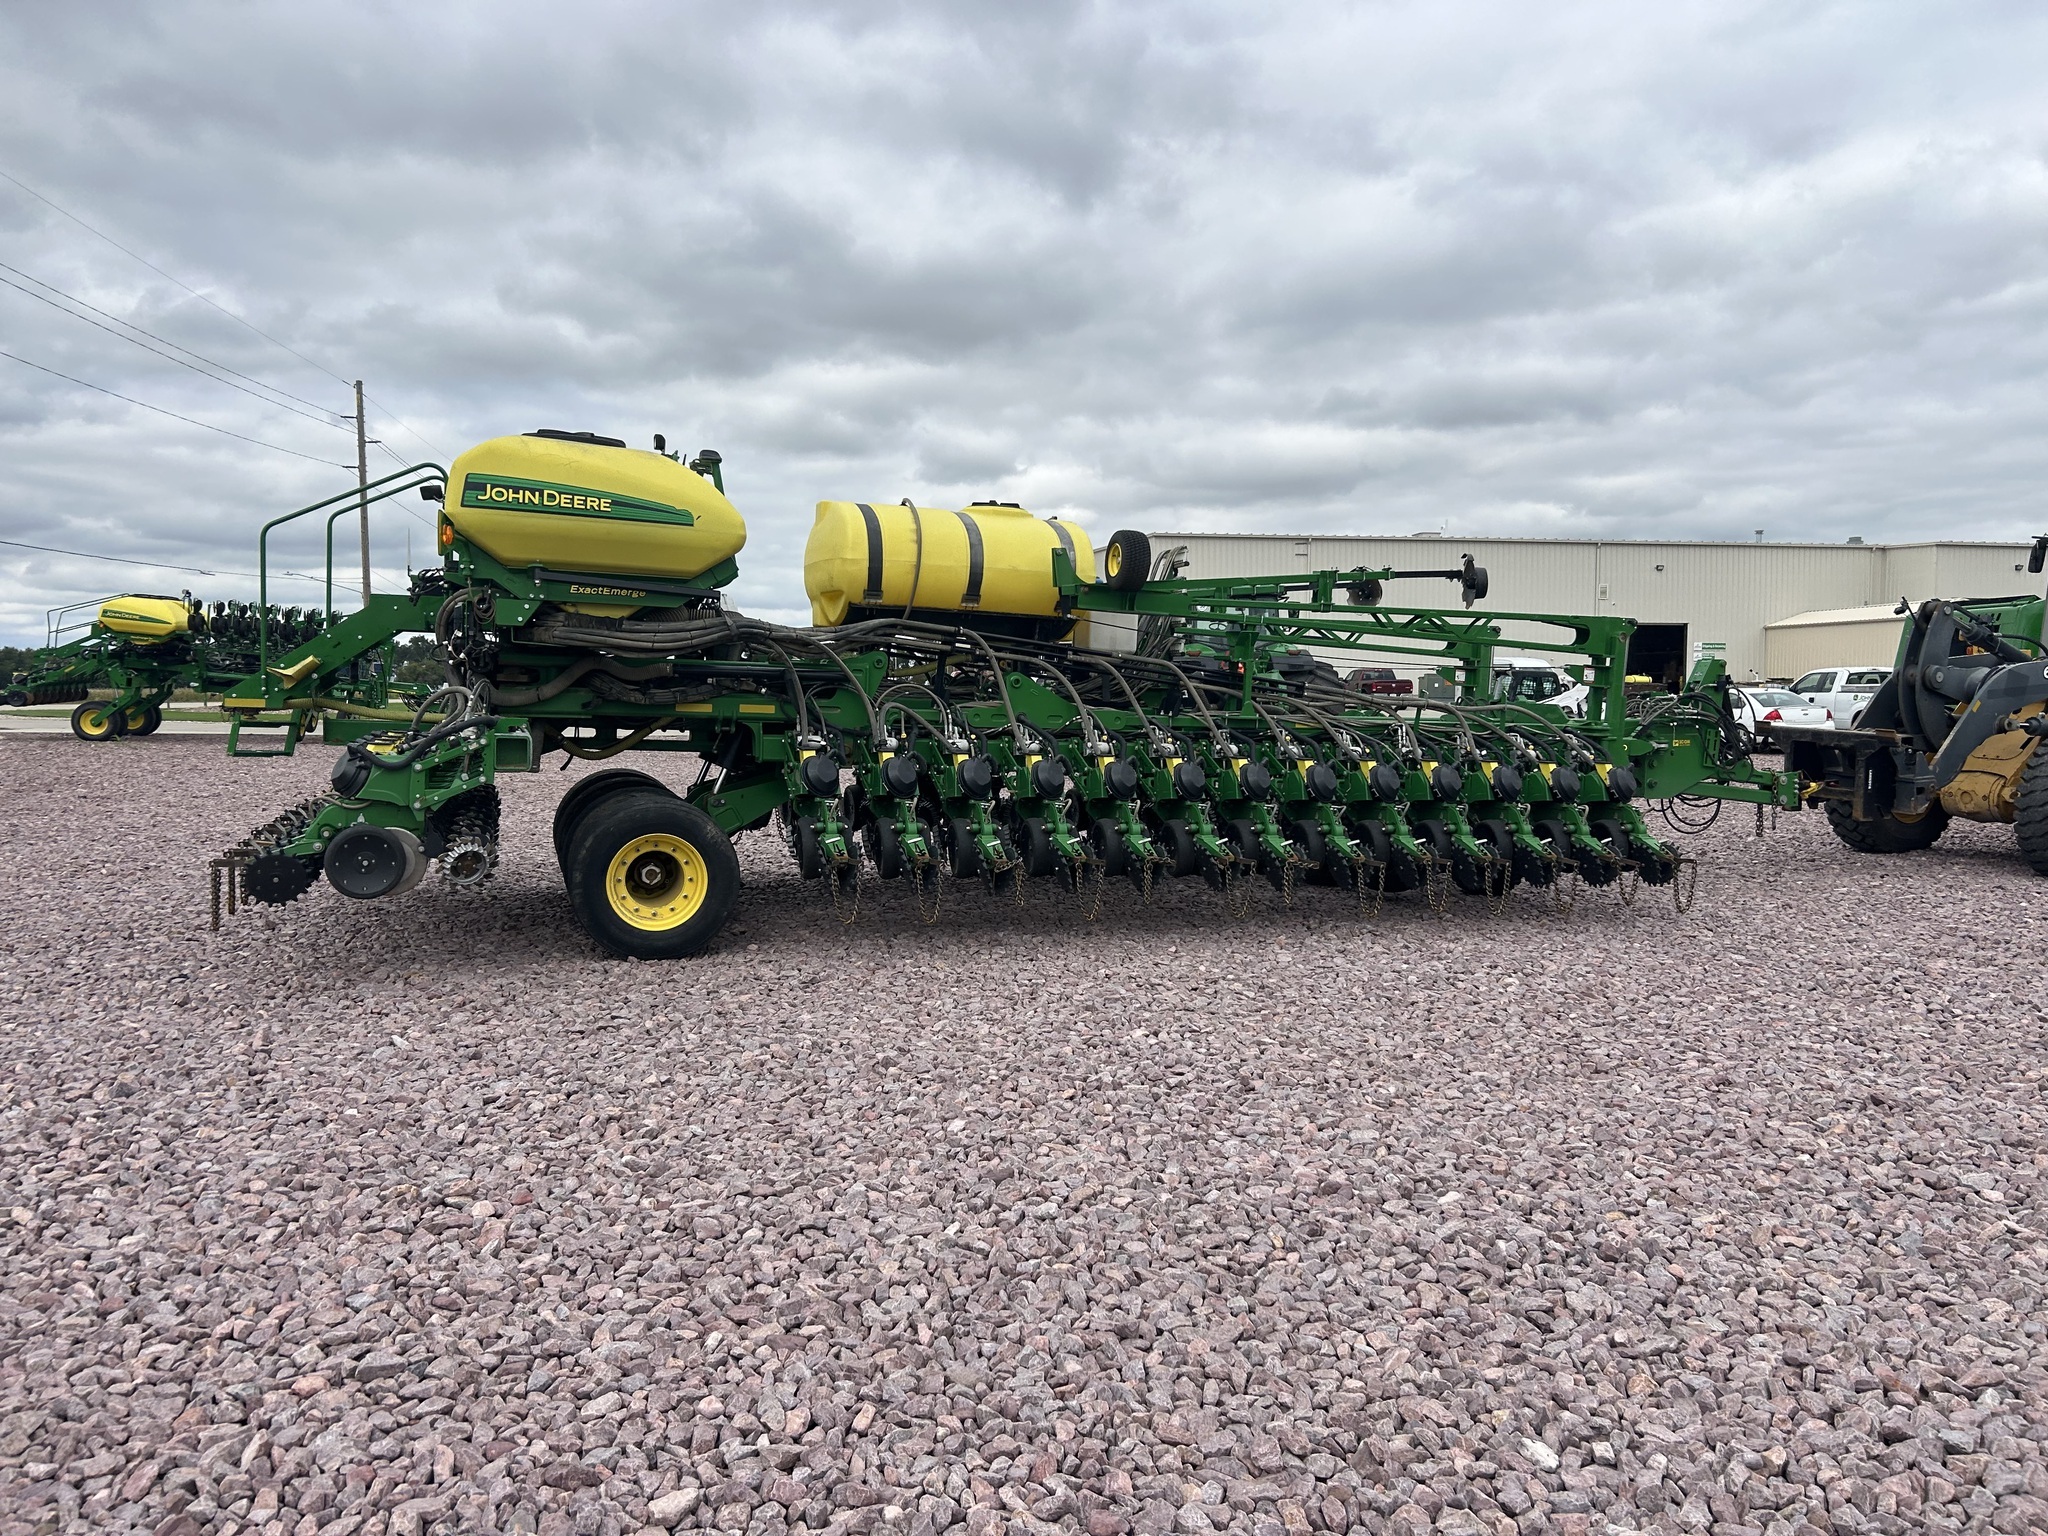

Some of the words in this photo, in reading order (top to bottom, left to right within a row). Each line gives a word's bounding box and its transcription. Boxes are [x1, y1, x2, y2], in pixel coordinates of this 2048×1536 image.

[477, 483, 540, 505] JOHN
[543, 488, 613, 513] DEERE
[570, 584, 647, 598] ExactEmerge
